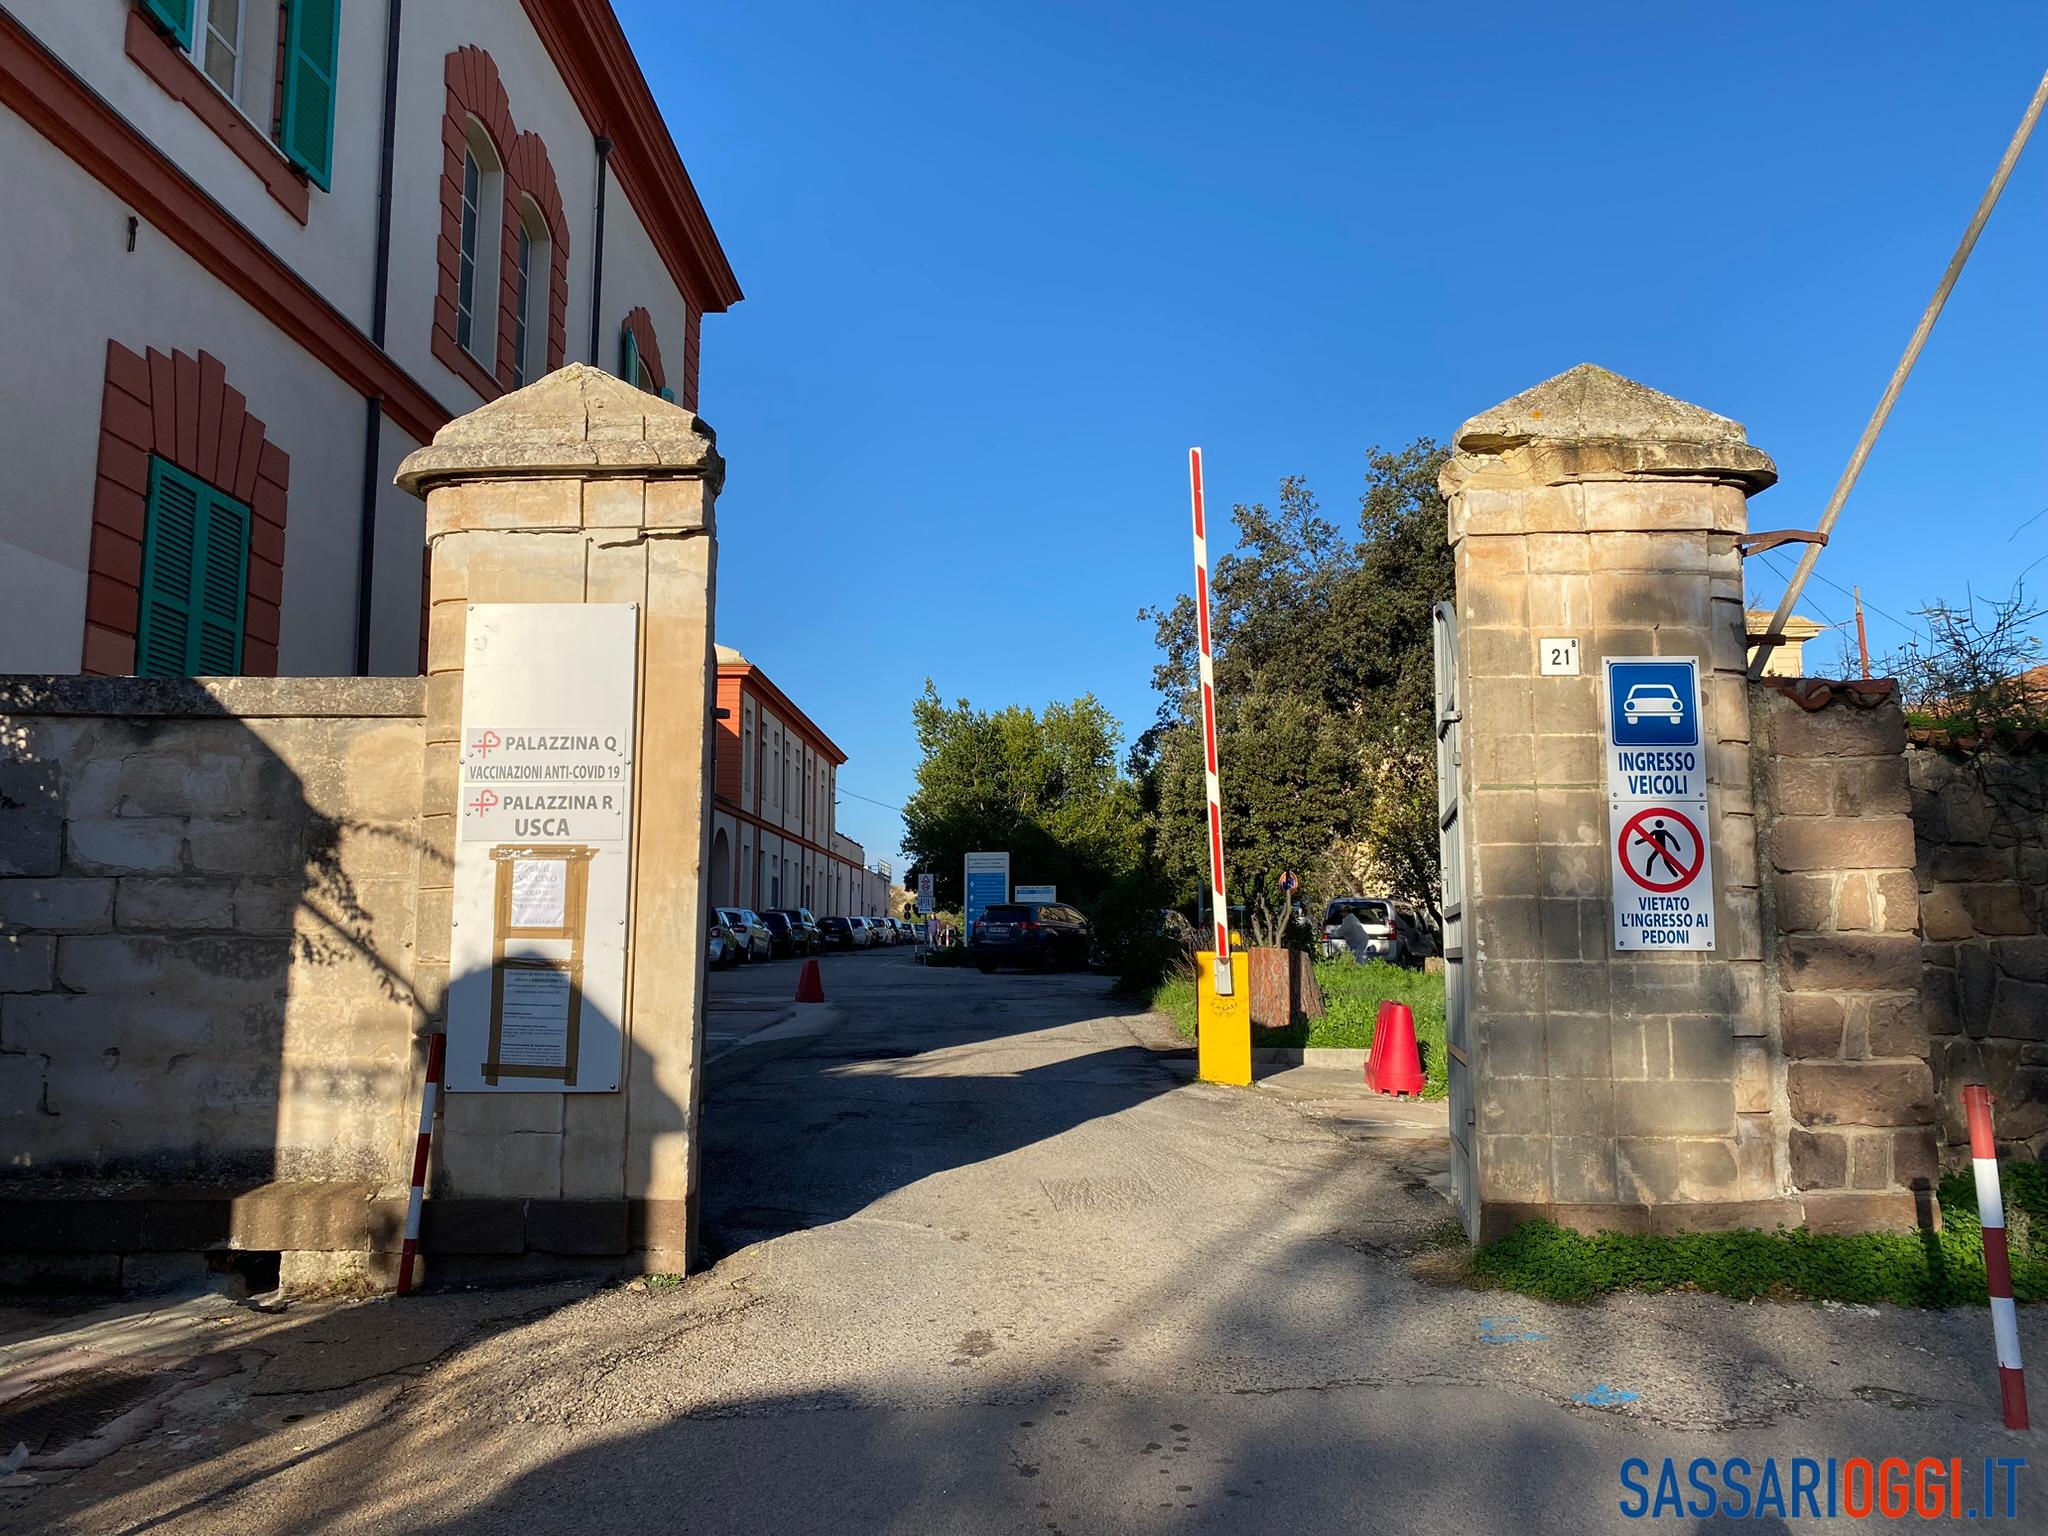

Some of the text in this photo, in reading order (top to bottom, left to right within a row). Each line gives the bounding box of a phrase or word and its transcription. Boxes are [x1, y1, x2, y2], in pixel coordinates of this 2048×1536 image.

[1552, 649, 1569, 665] 21
[505, 736, 617, 752] PALAZZINA Q
[1618, 751, 1696, 772] INGRESSO
[470, 765, 620, 780] VACCINAZIONI ANTI-COVID 19
[1627, 775, 1688, 795] VEICOLI
[503, 795, 613, 810] PALAZZINA R
[515, 818, 570, 837] USCA
[1638, 896, 1690, 911] VIETATO
[1621, 913, 1709, 928] L'INGRESSO AI
[1642, 929, 1690, 944] PEDONI
